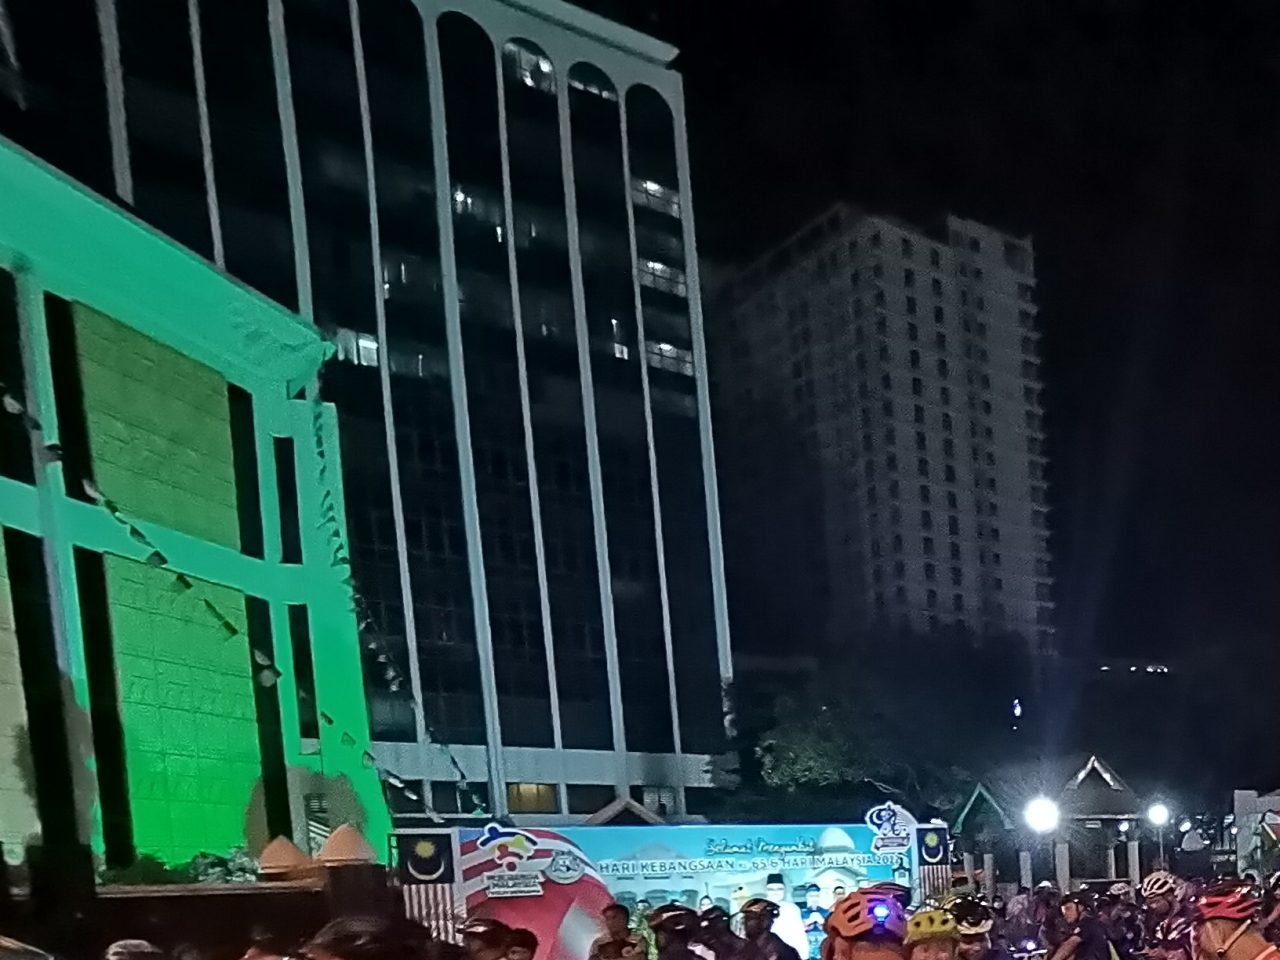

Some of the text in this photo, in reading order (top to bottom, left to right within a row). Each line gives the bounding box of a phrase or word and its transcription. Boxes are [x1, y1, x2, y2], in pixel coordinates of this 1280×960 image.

[600, 861, 635, 874] HARI
[641, 859, 735, 873] KEBANGSAAN
[816, 855, 873, 866] MALAYSIA
